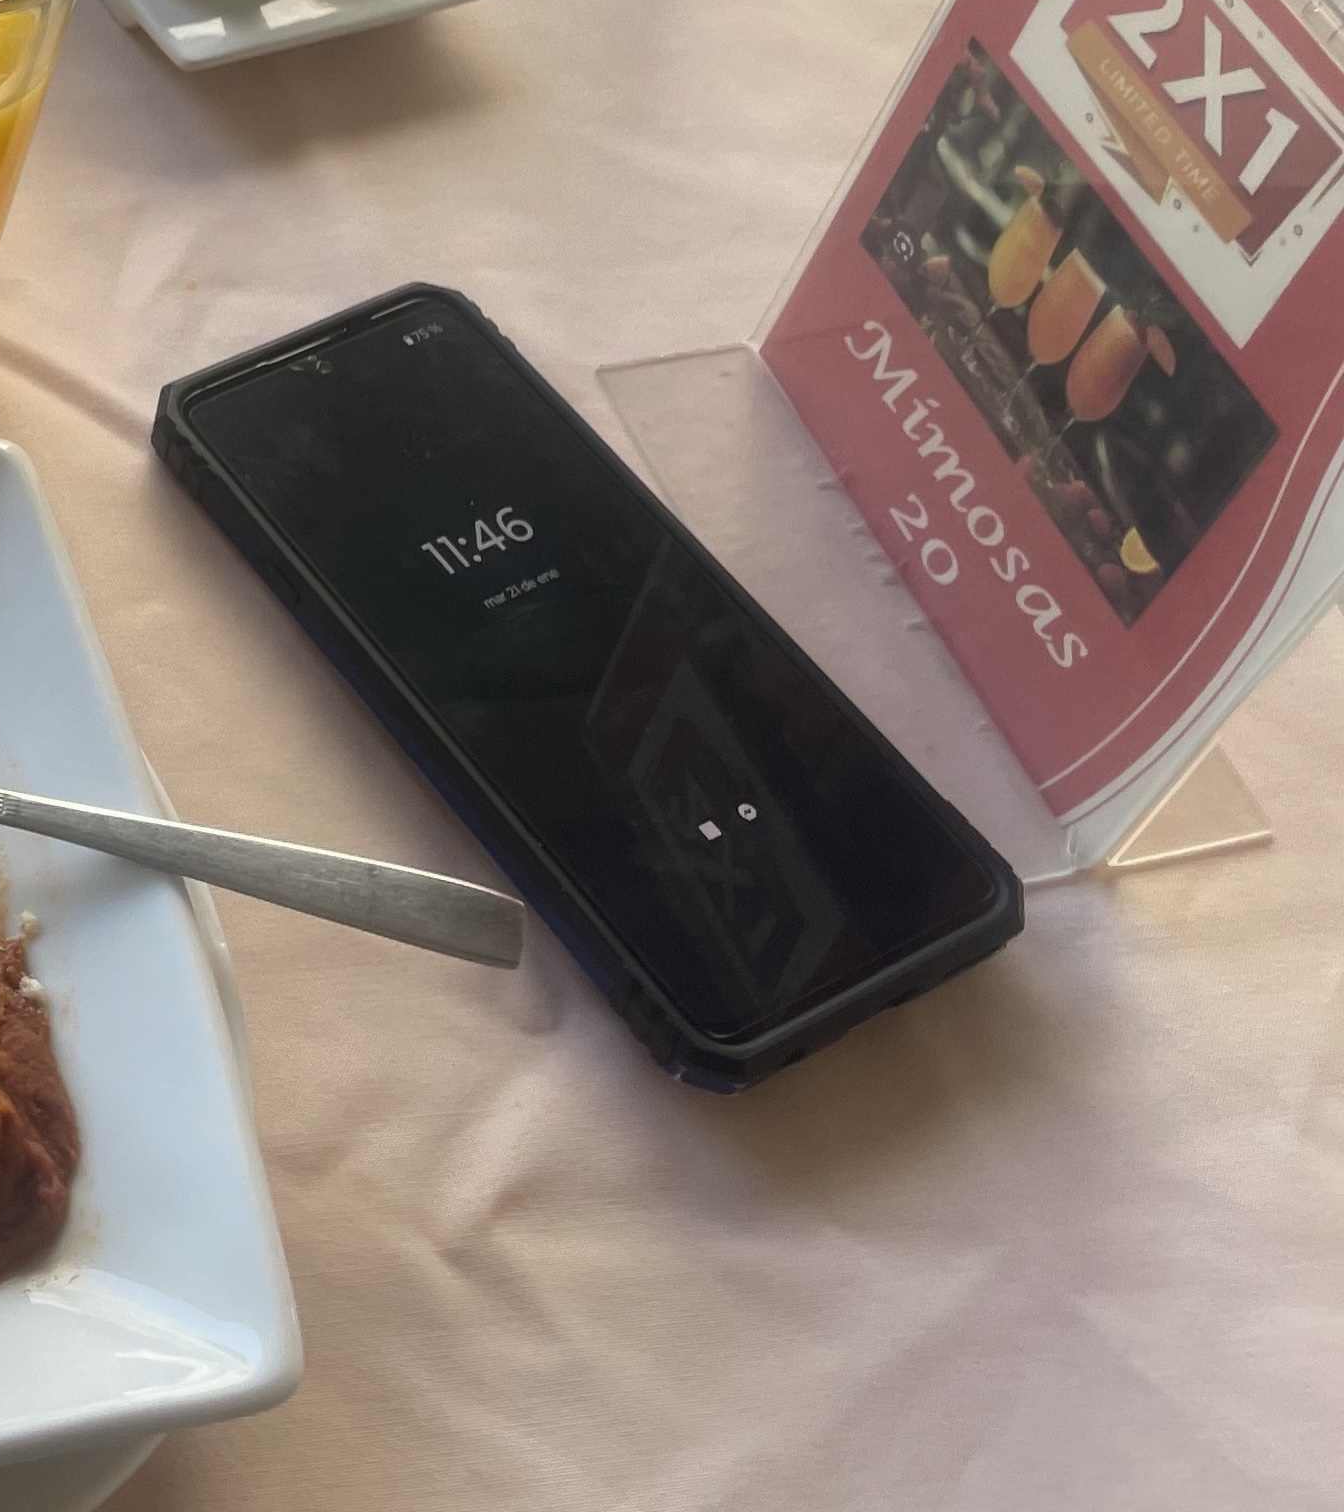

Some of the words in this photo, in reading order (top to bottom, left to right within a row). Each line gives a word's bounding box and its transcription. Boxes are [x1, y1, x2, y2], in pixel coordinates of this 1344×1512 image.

[1099, 58, 1172, 145] LIMITED
[1174, 149, 1219, 202] TIME
[421, 506, 534, 574] 11:46
[845, 320, 1089, 668] Mimosas
[889, 493, 959, 585] 20
[483, 592, 507, 610] mar
[520, 578, 537, 592] de
[536, 568, 560, 584] ene
